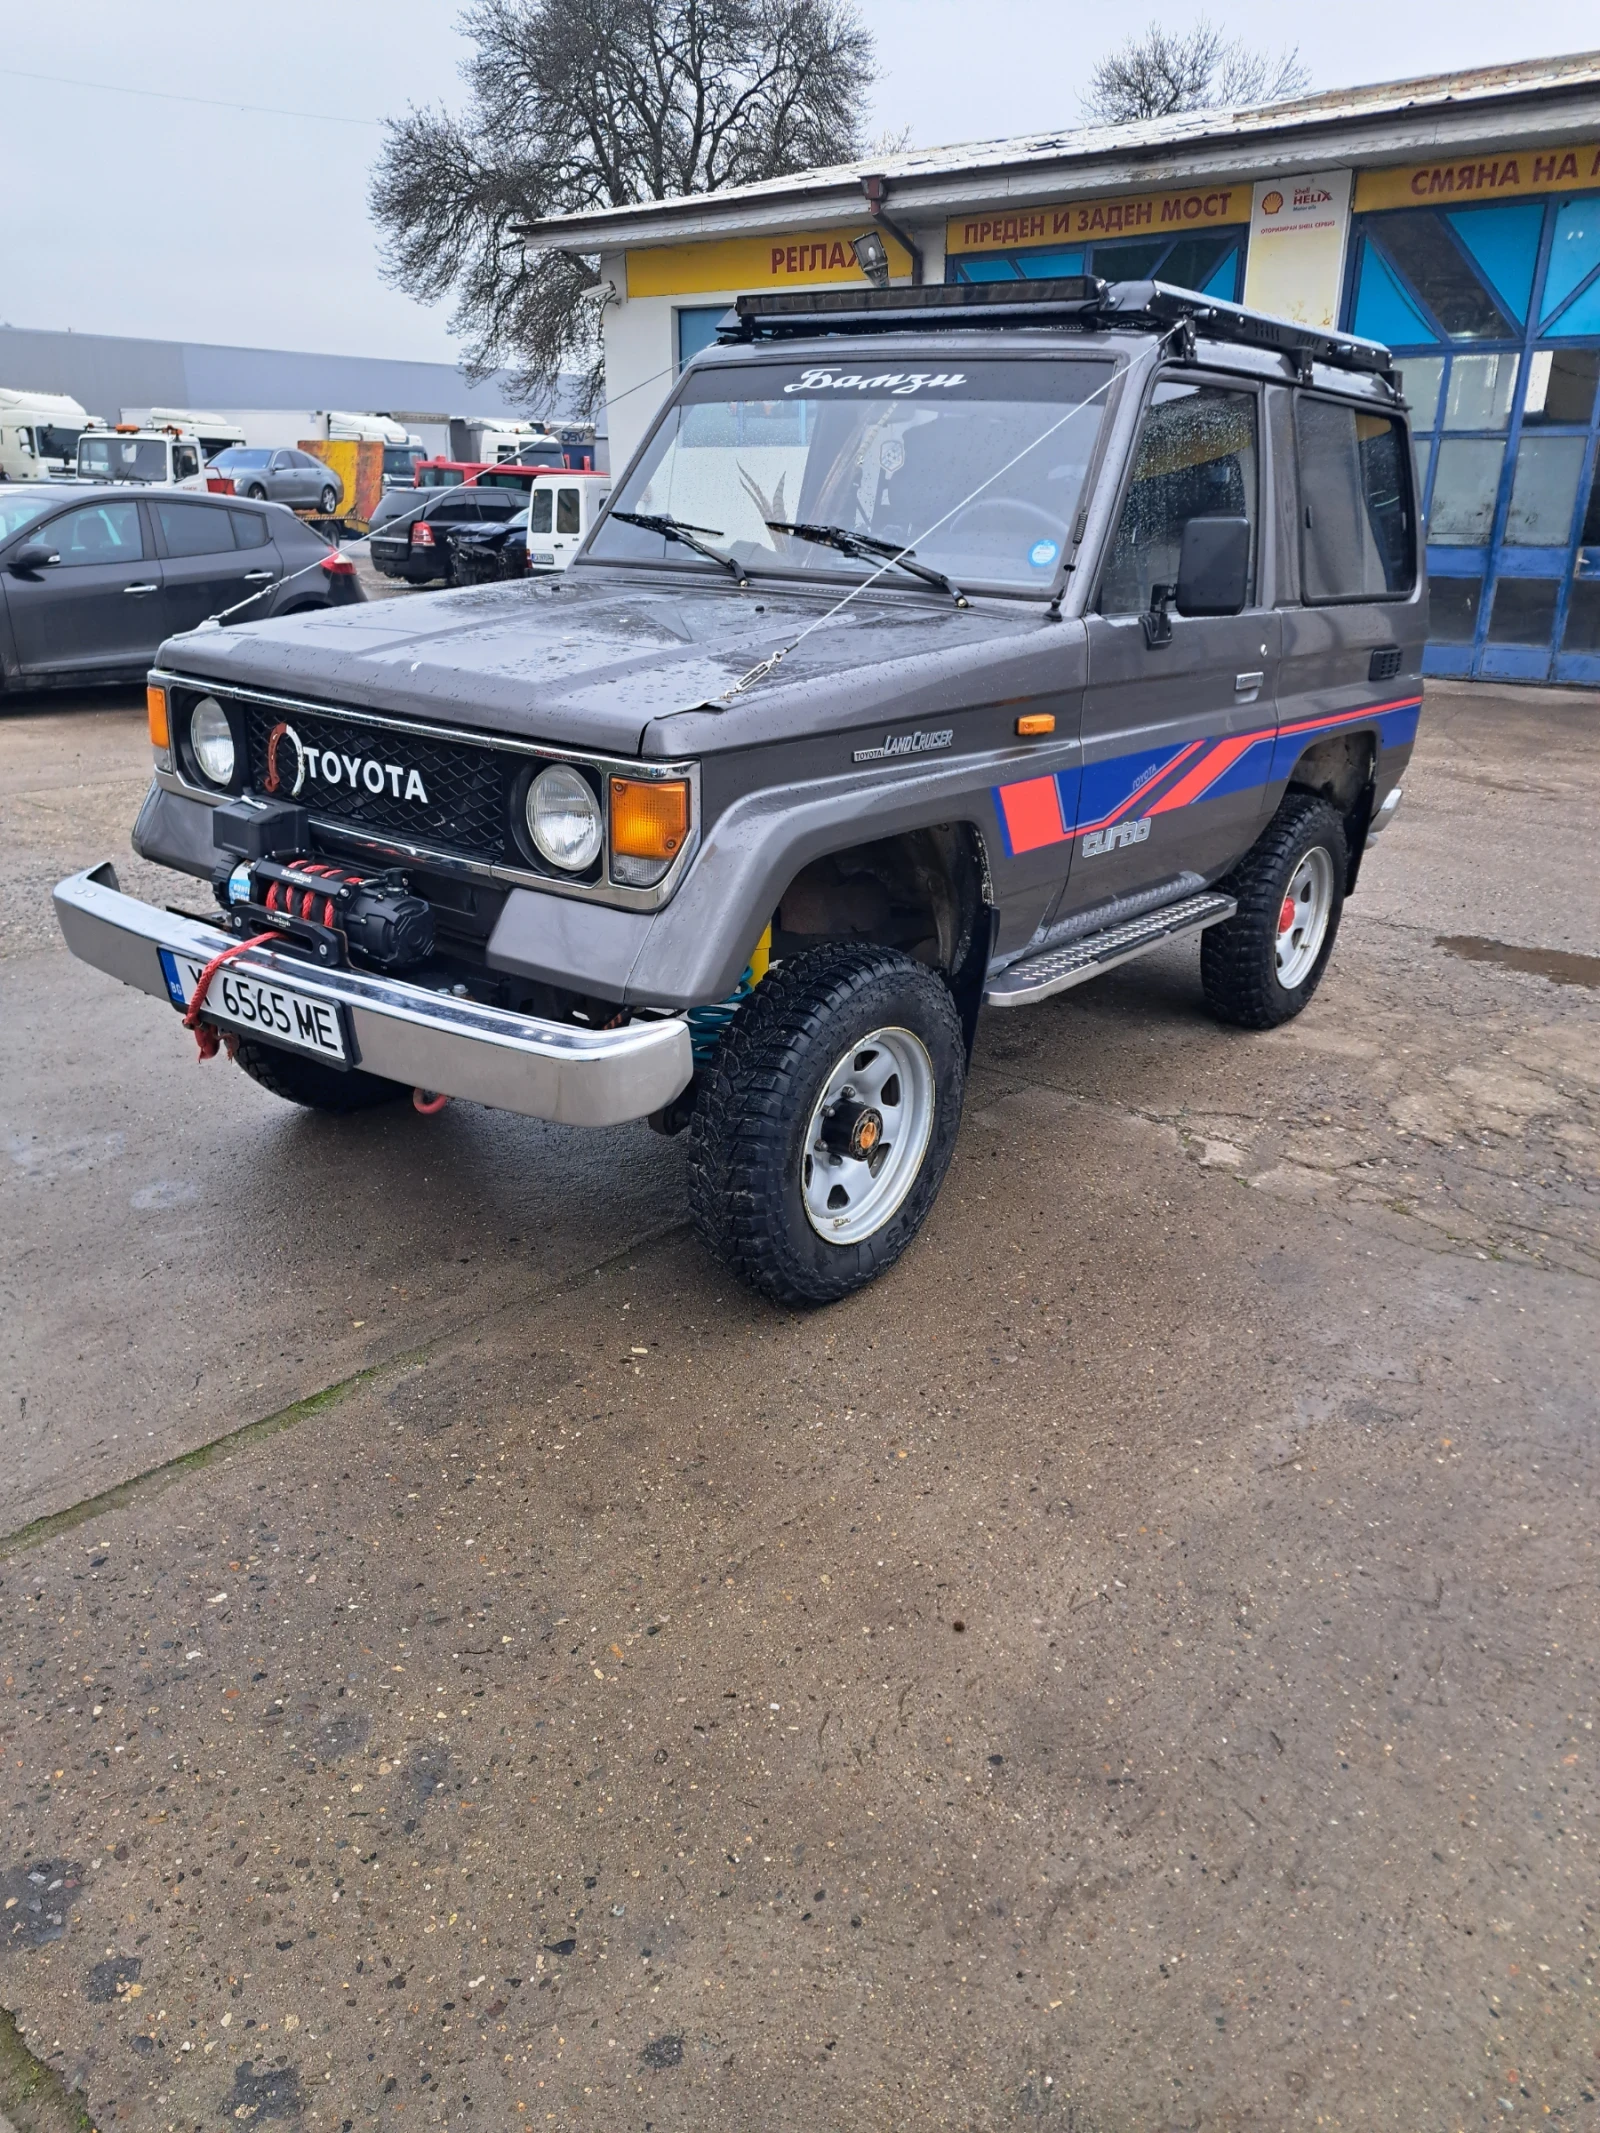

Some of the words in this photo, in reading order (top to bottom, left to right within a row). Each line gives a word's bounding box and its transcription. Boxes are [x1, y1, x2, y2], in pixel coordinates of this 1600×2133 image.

[1411, 160, 1520, 196] СМЯНА
[1532, 153, 1578, 182] НА
[1293, 189, 1333, 206] HELIX
[1294, 187, 1310, 196] Shell
[964, 216, 1045, 244] ПРЕДЕН
[1052, 211, 1070, 234] И
[1077, 202, 1152, 232] ЗАДЕН
[1160, 192, 1232, 222] МОСТ
[561, 431, 586, 444] DSV
[856, 750, 882, 760] TOYOTA
[302, 746, 429, 804] TOYOTA
[1132, 764, 1157, 790] TOYOTA
[170, 982, 183, 995] BG
